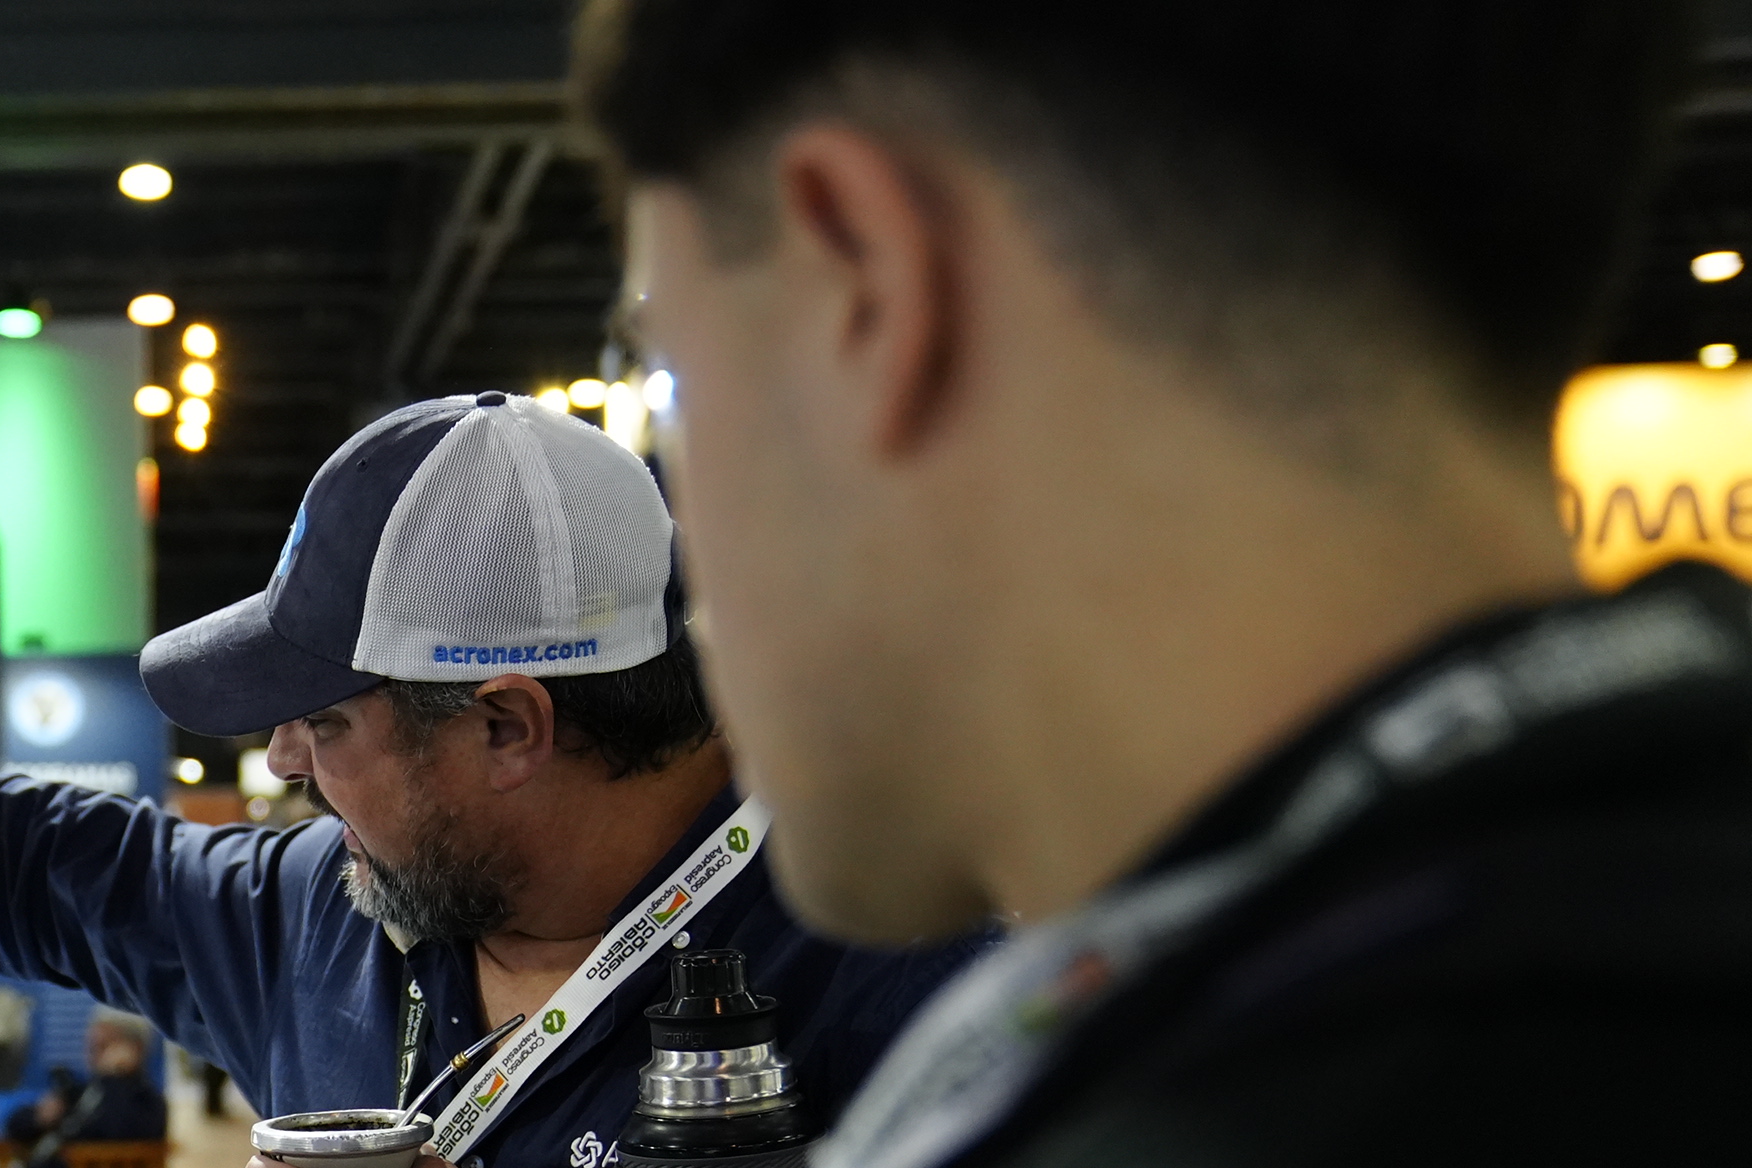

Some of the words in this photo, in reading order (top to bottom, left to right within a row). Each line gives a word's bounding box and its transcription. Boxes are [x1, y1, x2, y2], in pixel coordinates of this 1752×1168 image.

[433, 638, 598, 665] acronex.com
[684, 845, 724, 885] Aapresid
[690, 854, 732, 893] Congreso
[646, 885, 678, 914] Expoagro
[586, 916, 648, 980] ABIERTO
[501, 1028, 538, 1068] Aapresid
[506, 1036, 545, 1075] Congreso
[470, 1067, 497, 1098] Expoagro
